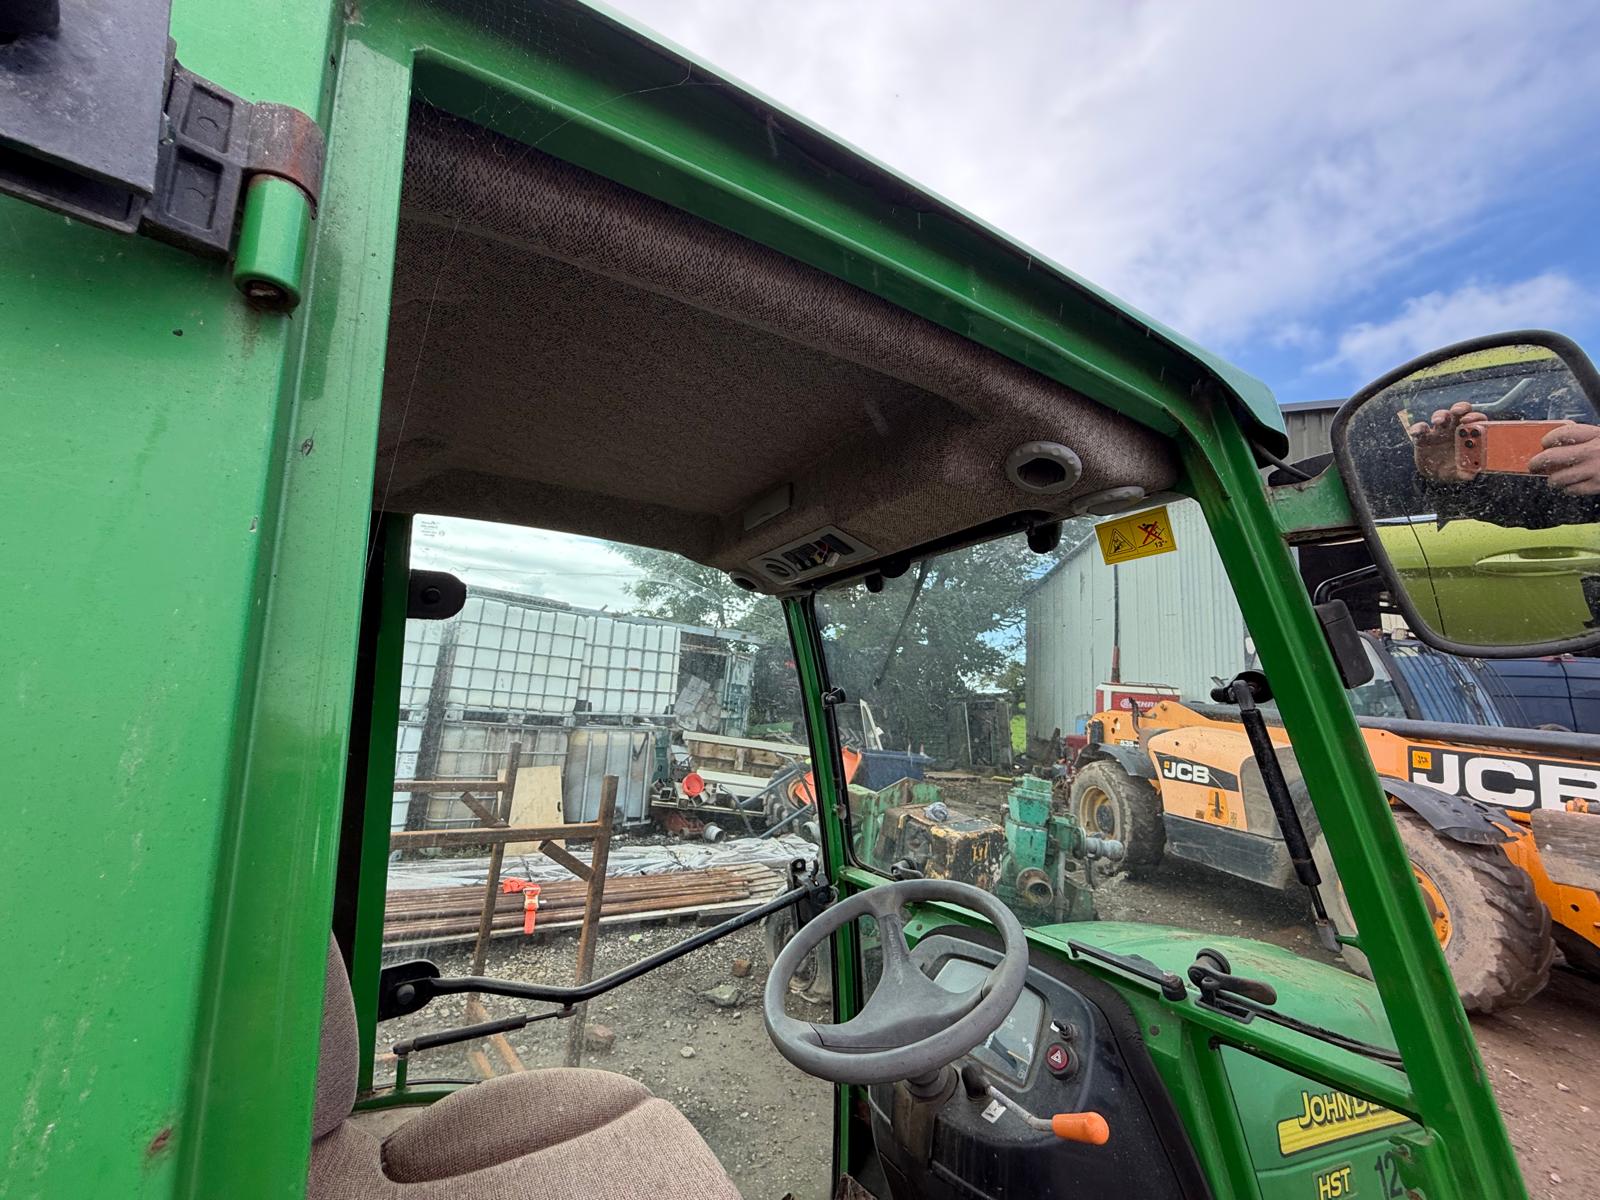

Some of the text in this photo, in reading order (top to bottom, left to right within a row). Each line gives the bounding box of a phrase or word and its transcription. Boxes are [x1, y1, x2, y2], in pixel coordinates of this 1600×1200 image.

[1163, 761, 1210, 784] JCB
[1299, 1090, 1352, 1128] JOHN
[1317, 1166, 1351, 1200] HST
